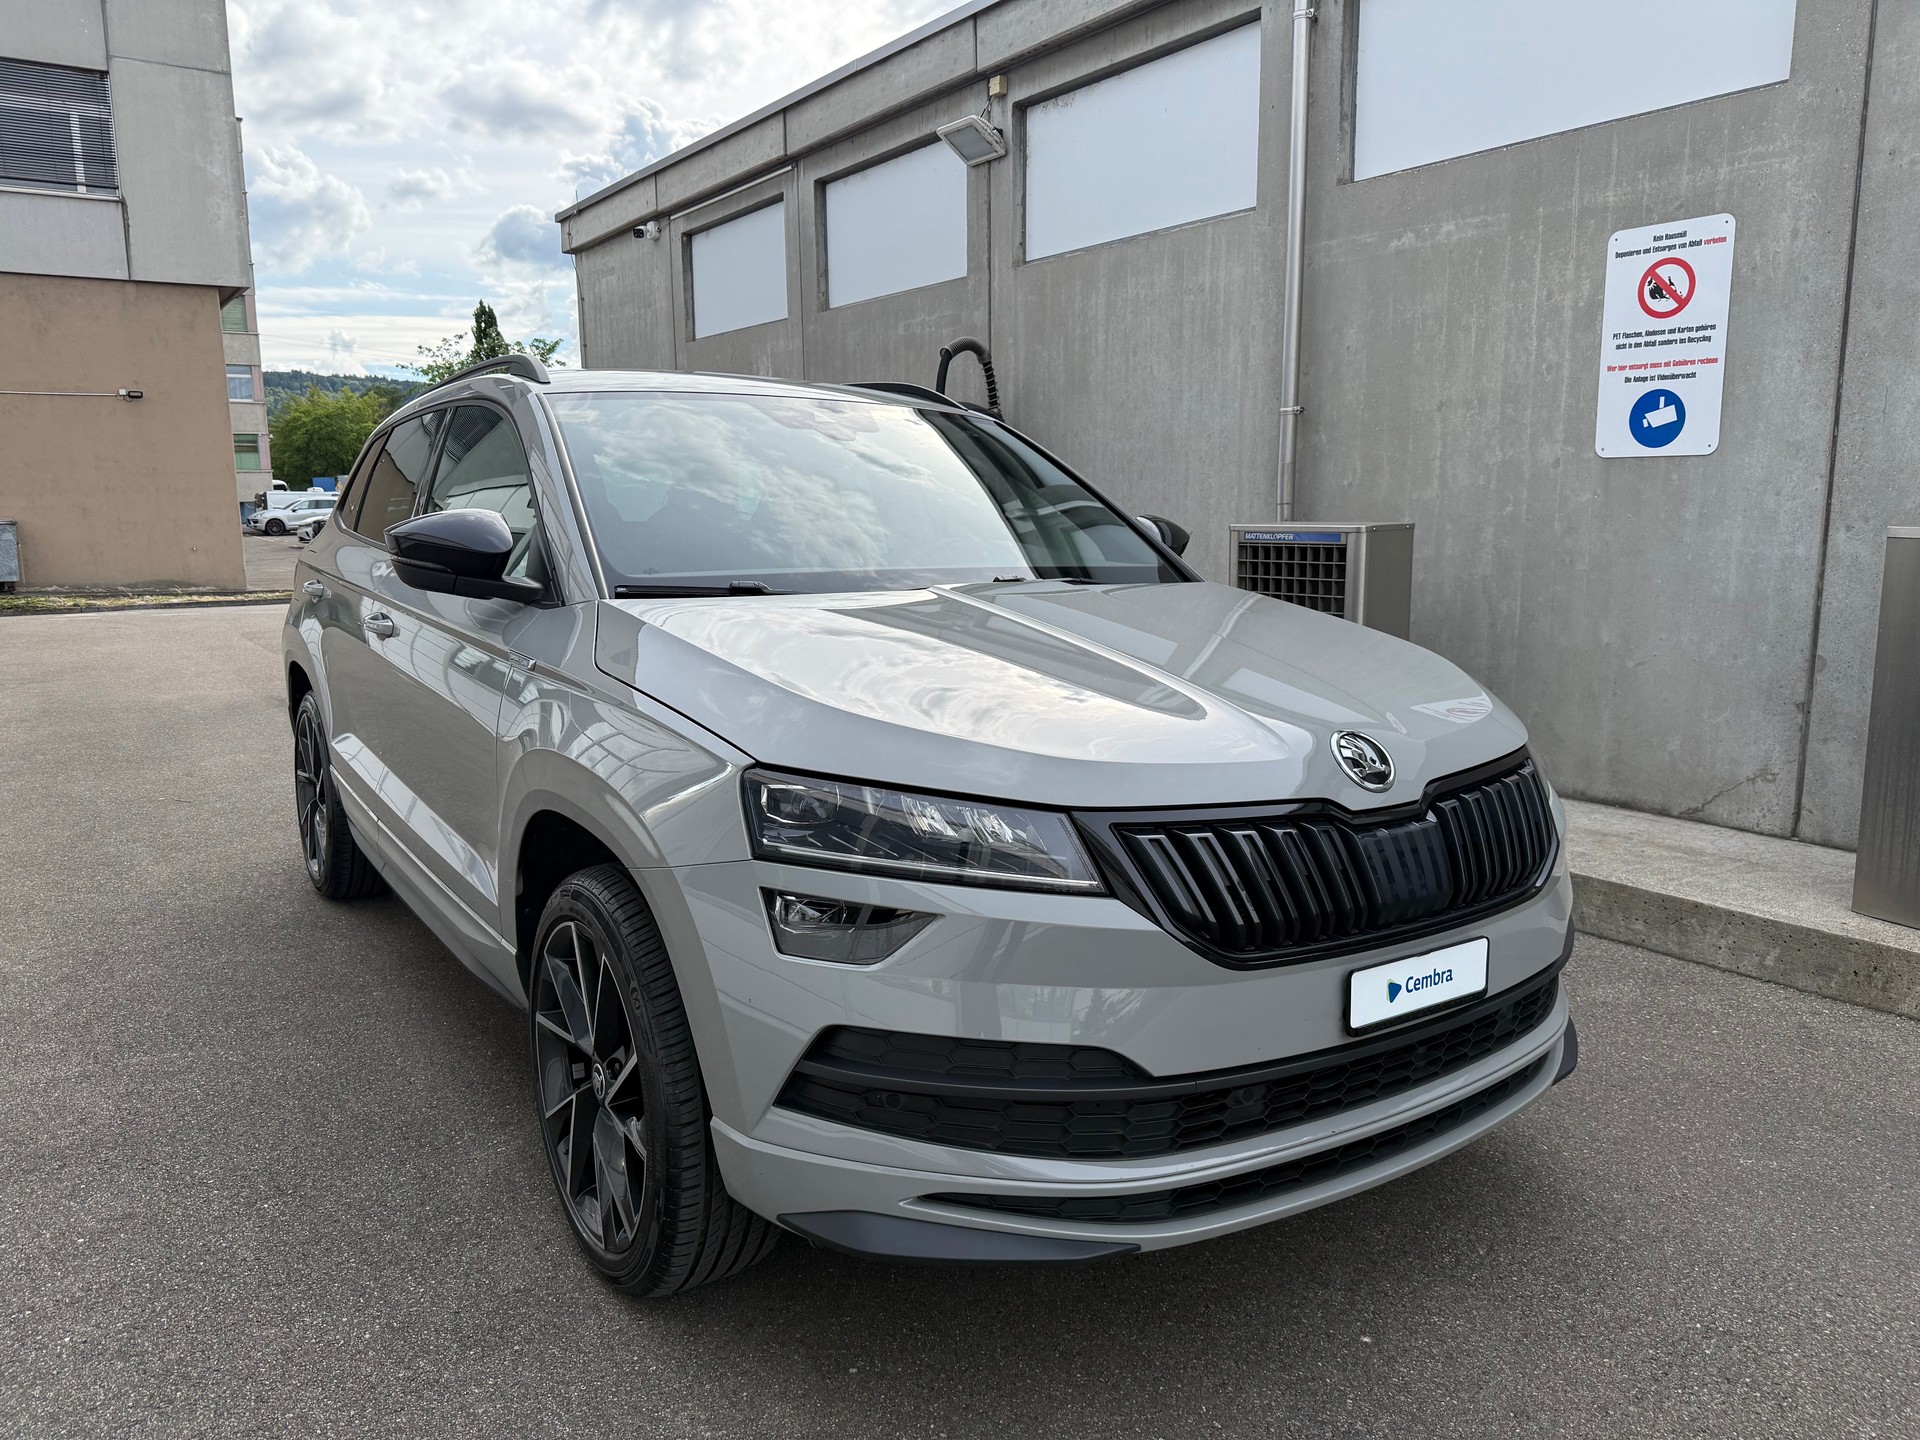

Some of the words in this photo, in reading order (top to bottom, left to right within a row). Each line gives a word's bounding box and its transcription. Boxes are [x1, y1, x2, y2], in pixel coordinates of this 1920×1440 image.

[1653, 234, 1664, 242] Kein
[1615, 249, 1642, 258] Deponieren
[1652, 244, 1677, 252] Entsorgen
[1688, 239, 1702, 248] Abfall
[1704, 236, 1727, 245] verboten
[1645, 328, 1666, 336] Aludosen
[1695, 324, 1716, 332] gehören
[1658, 338, 1678, 346] sondern
[1687, 335, 1712, 344] Recycling
[1628, 362, 1648, 370] entsorgt
[1697, 357, 1718, 365] rechnen
[1633, 375, 1648, 383] Anlage
[1405, 968, 1454, 994] Cembra
